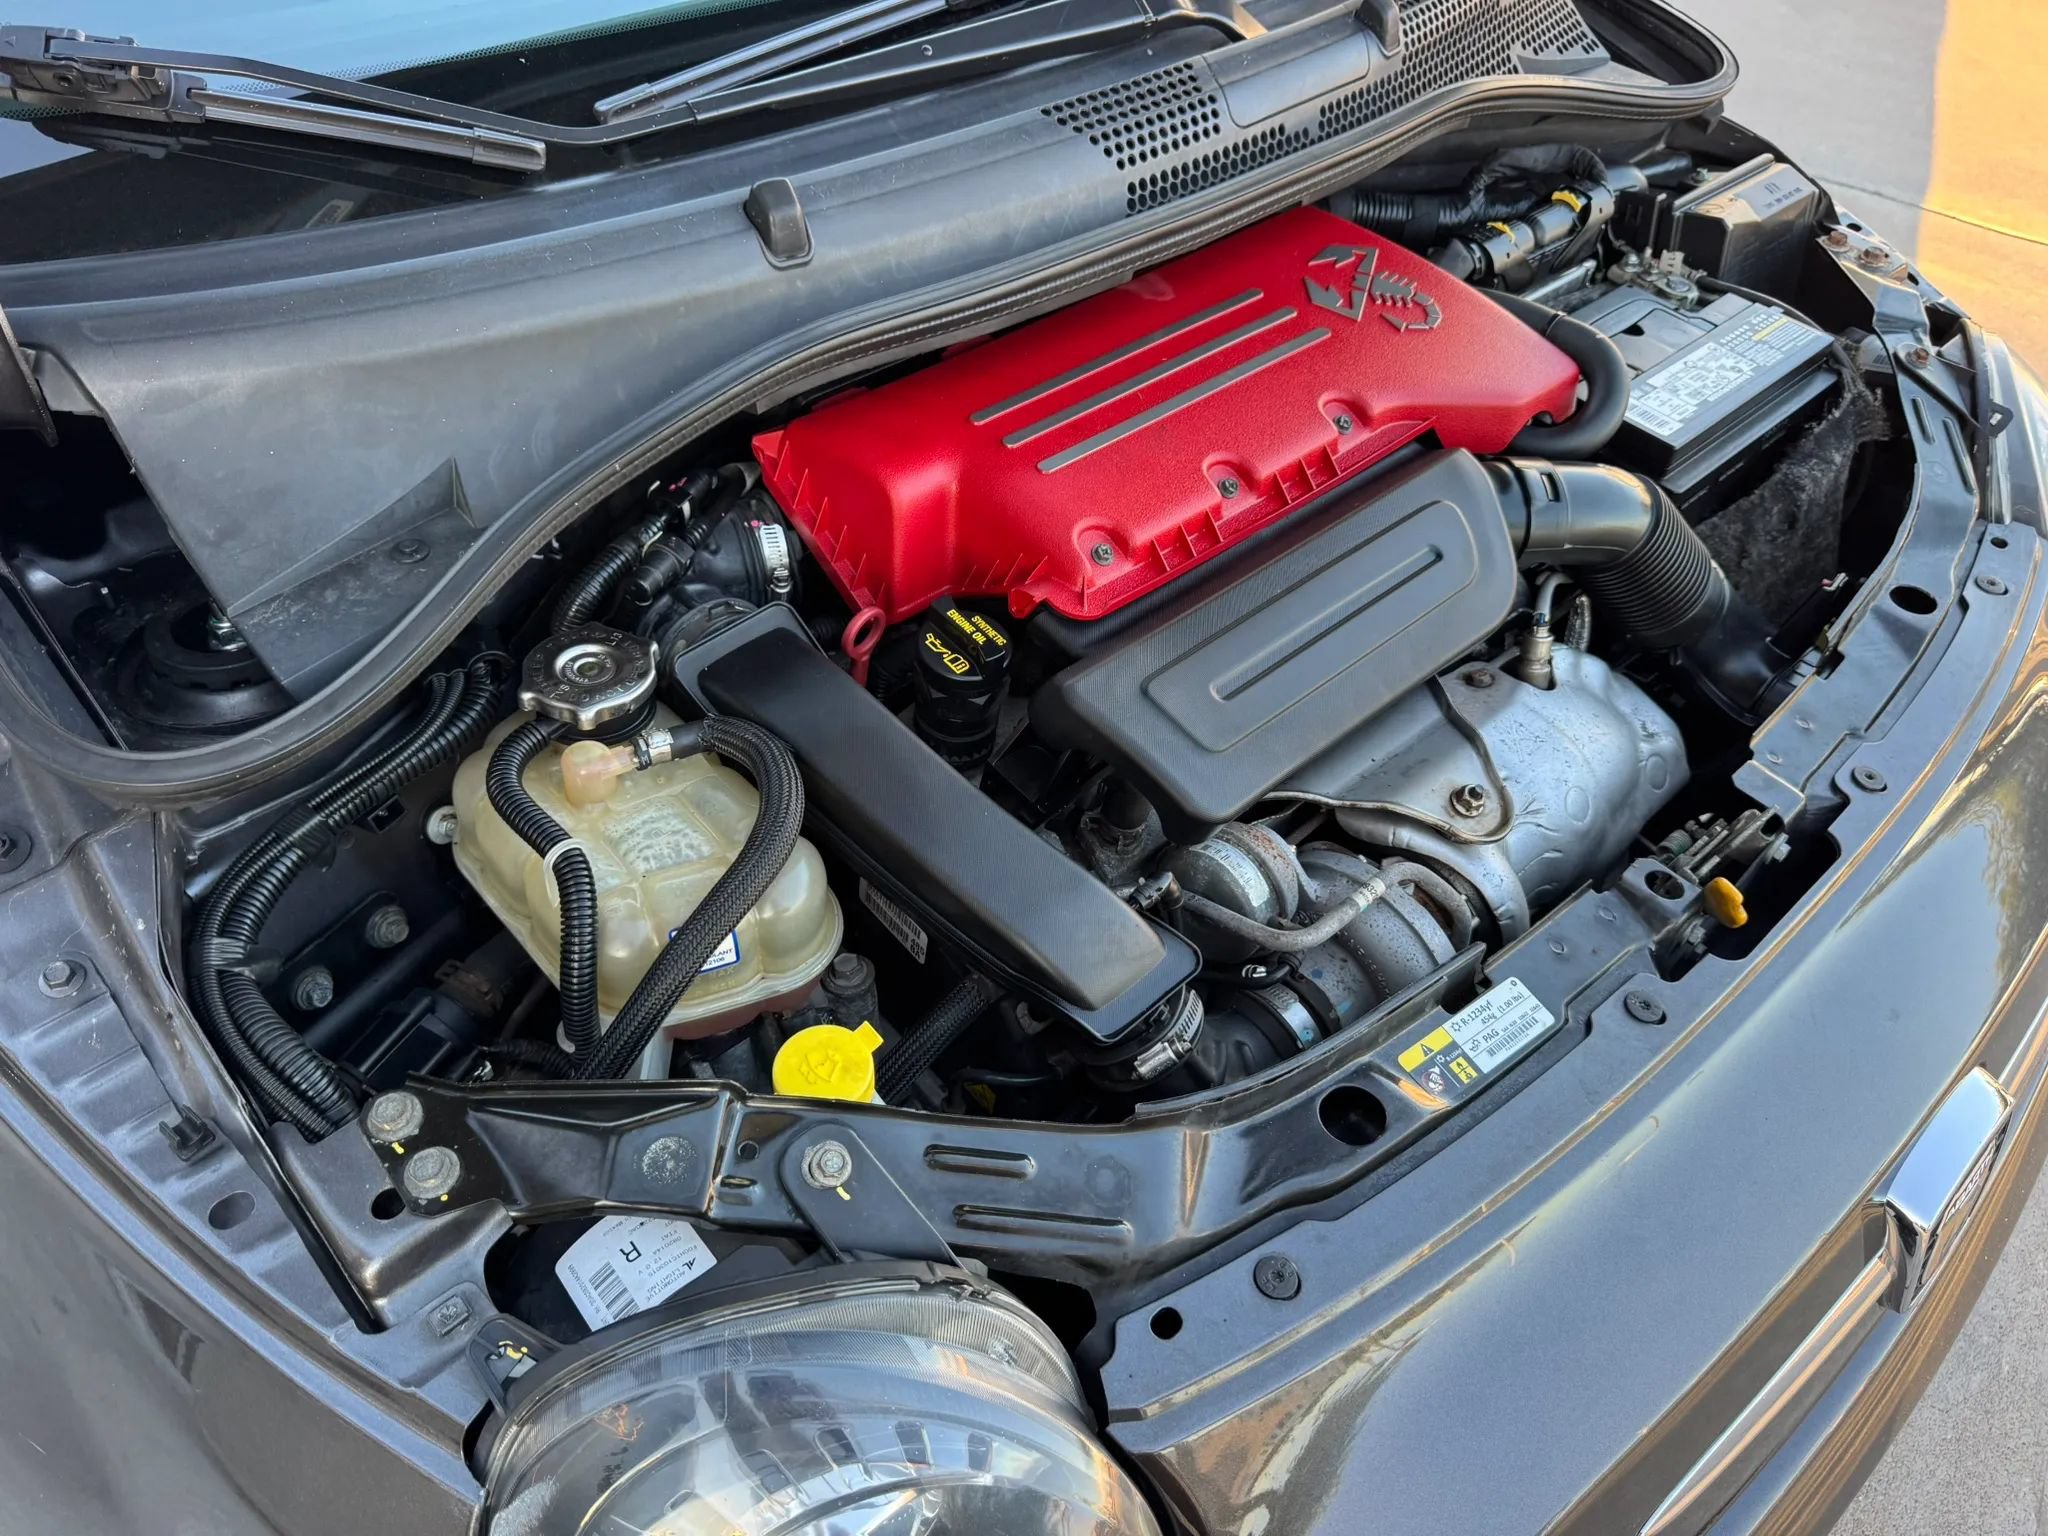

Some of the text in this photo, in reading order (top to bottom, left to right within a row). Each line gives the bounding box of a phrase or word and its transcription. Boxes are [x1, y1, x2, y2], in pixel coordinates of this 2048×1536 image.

[946, 608, 986, 646] ENGINE OIL
[971, 615, 1008, 647] SYNTHETIC
[1460, 999, 1494, 1027] R-1234yf
[1482, 1028, 1500, 1044] PAG
[619, 1240, 642, 1263] R
